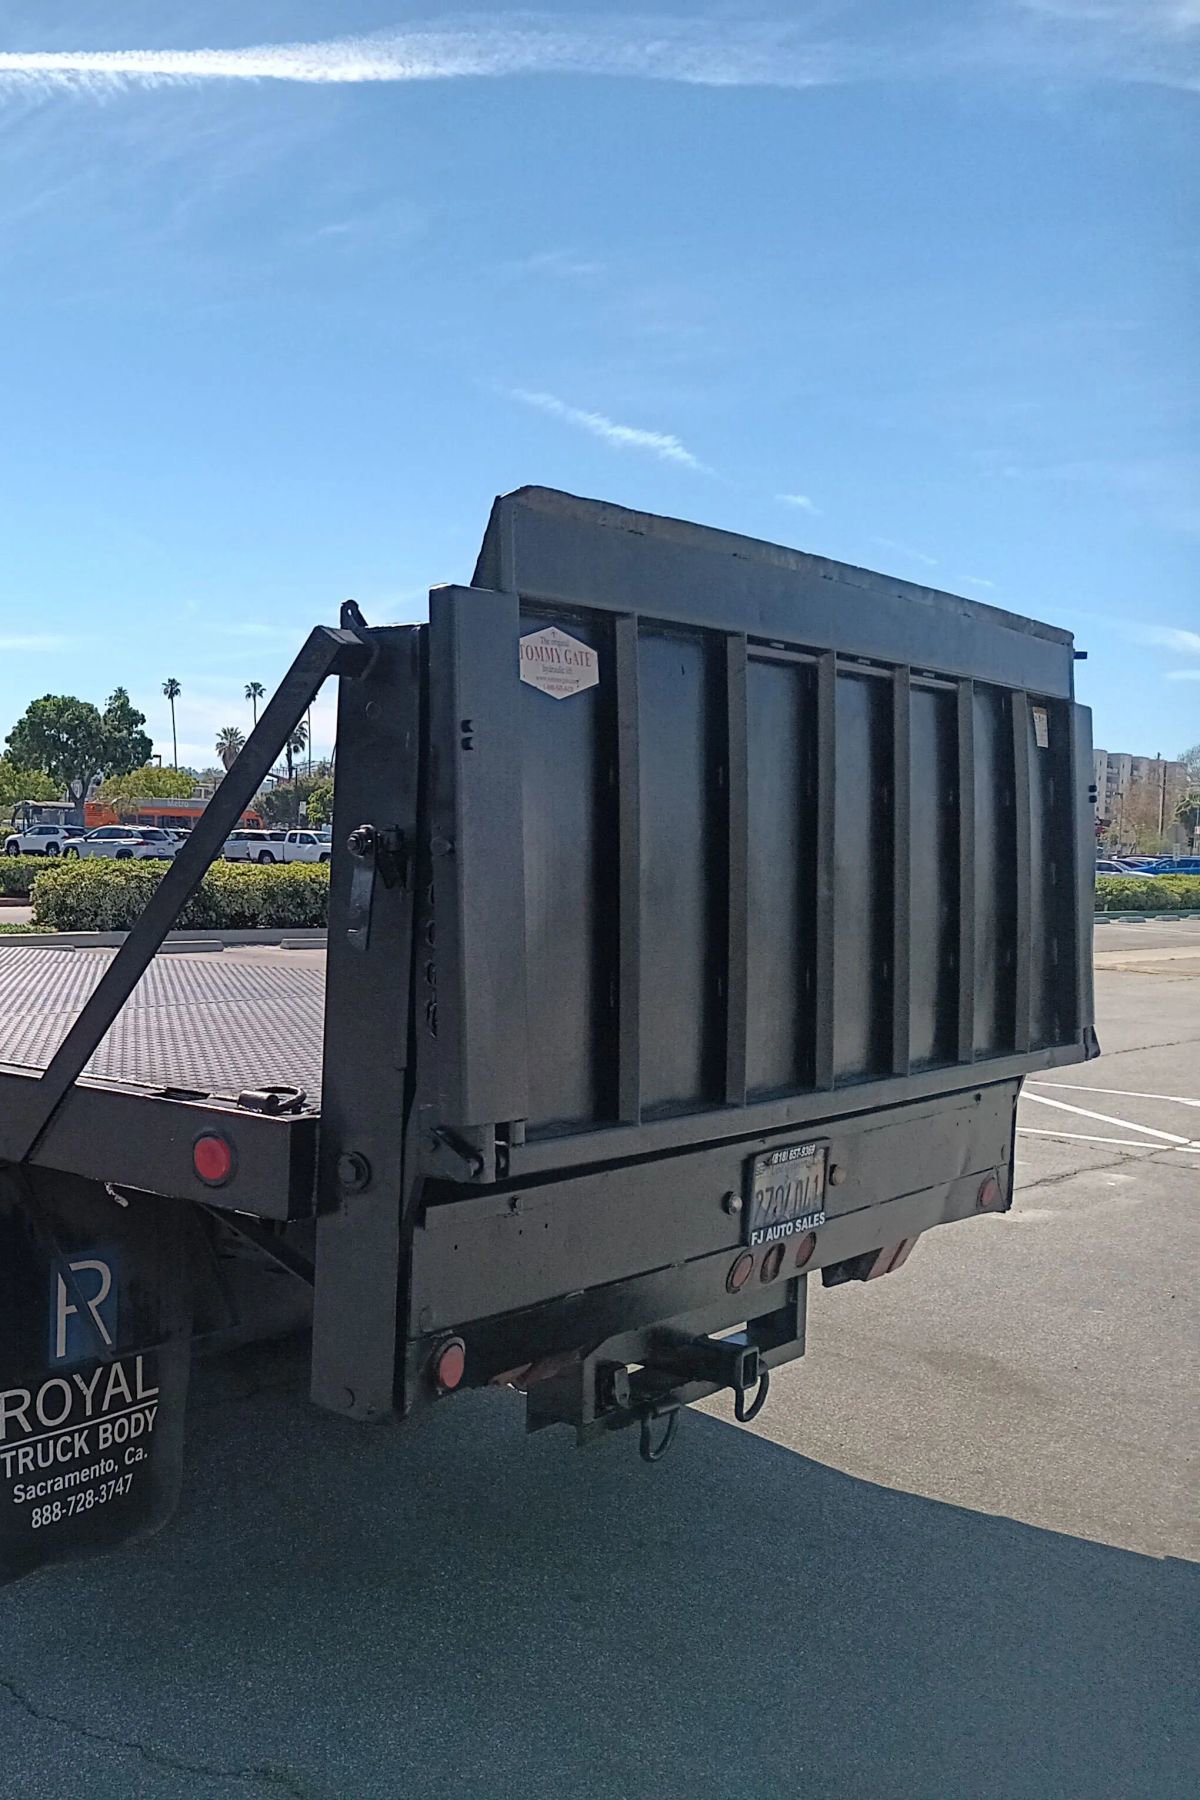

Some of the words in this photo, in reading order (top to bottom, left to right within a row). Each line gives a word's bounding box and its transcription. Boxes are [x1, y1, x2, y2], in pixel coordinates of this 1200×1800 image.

[520, 645, 561, 664] TOMMY
[565, 649, 592, 667] GATE
[772, 1150, 788, 1163] (818)
[751, 1230, 764, 1245] FJ
[766, 1223, 793, 1242] AUTO
[795, 1212, 826, 1232] SALES
[0, 1430, 90, 1478] TRUCK
[99, 1406, 158, 1449] BODY
[13, 1457, 118, 1504] Sacramento,
[124, 1446, 148, 1465] Ca.
[31, 1473, 133, 1529] 888-728-3747
